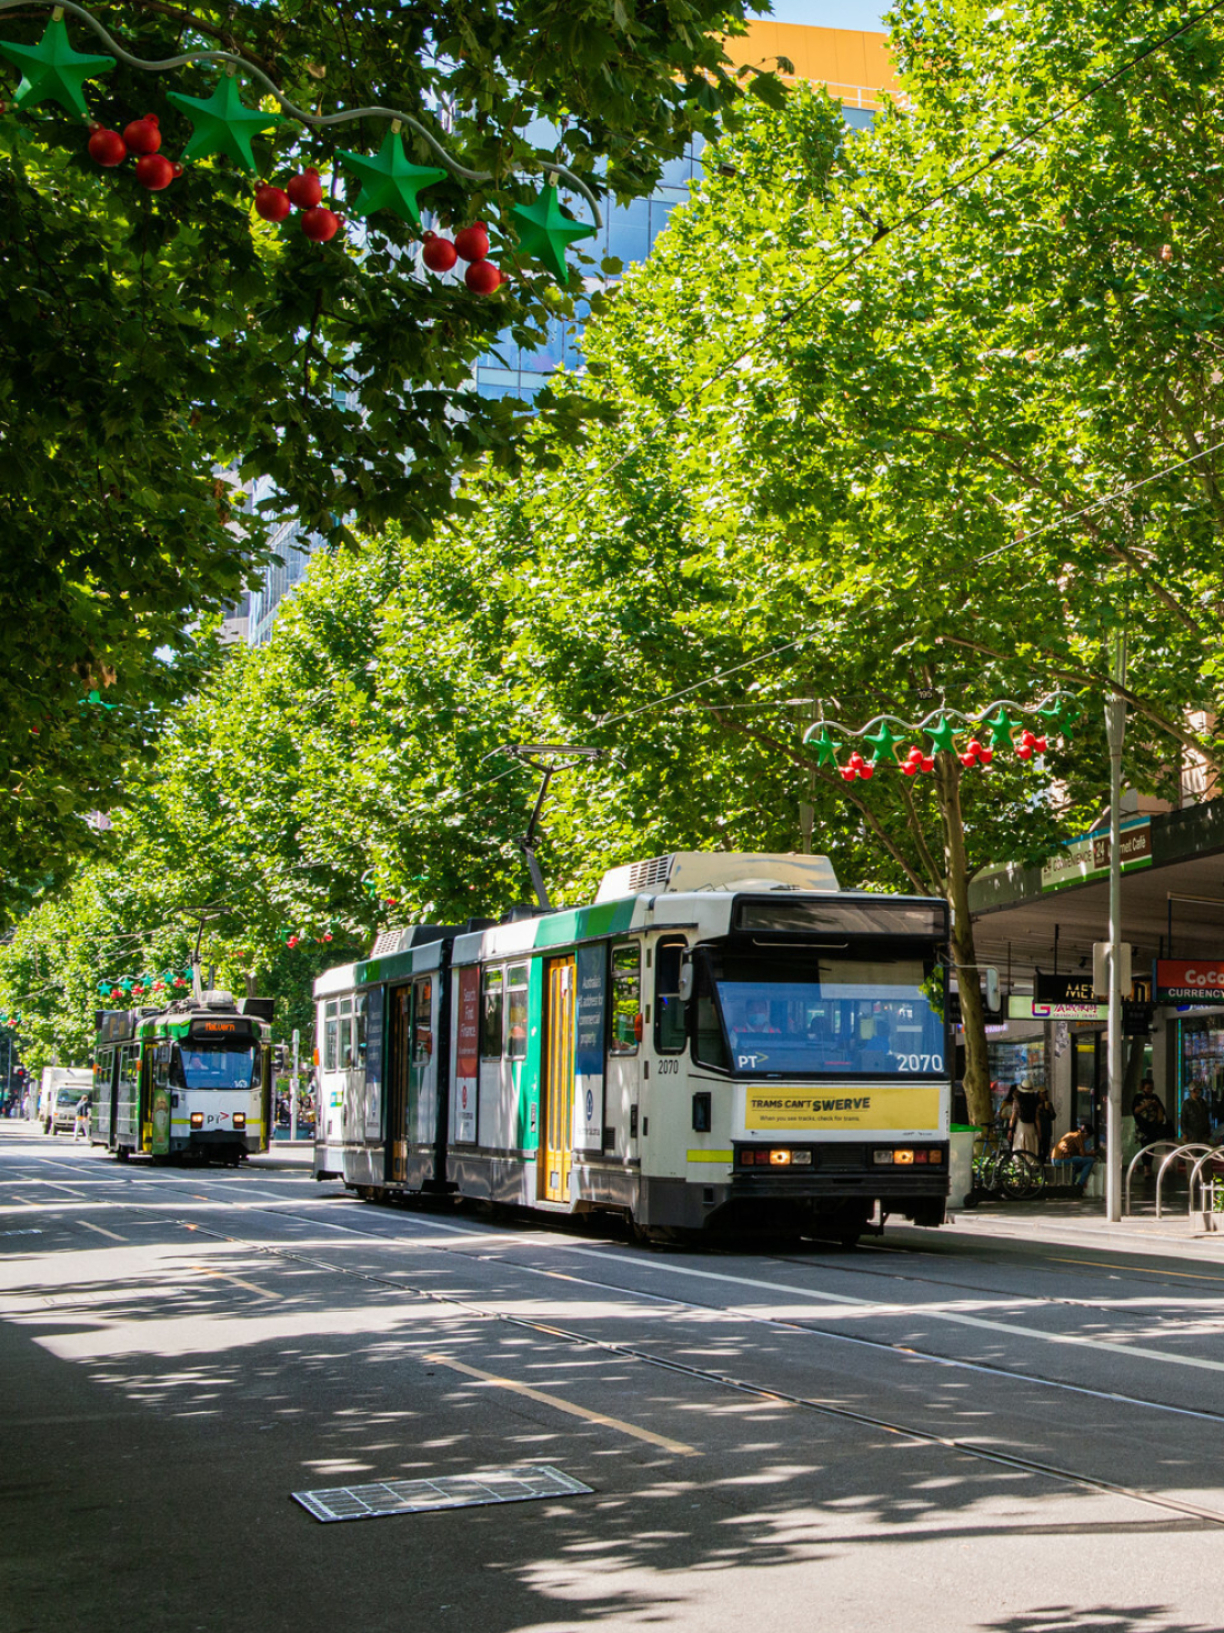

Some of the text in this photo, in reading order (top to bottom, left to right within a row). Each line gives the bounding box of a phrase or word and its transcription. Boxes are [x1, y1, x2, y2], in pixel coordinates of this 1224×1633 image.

[1095, 842, 1105, 857] 24
[1132, 834, 1147, 850] Café
[658, 1060, 679, 1075] 2070
[896, 1053, 944, 1072] 2070
[751, 1097, 871, 1112] TRAMS CAN'T SWERVE
